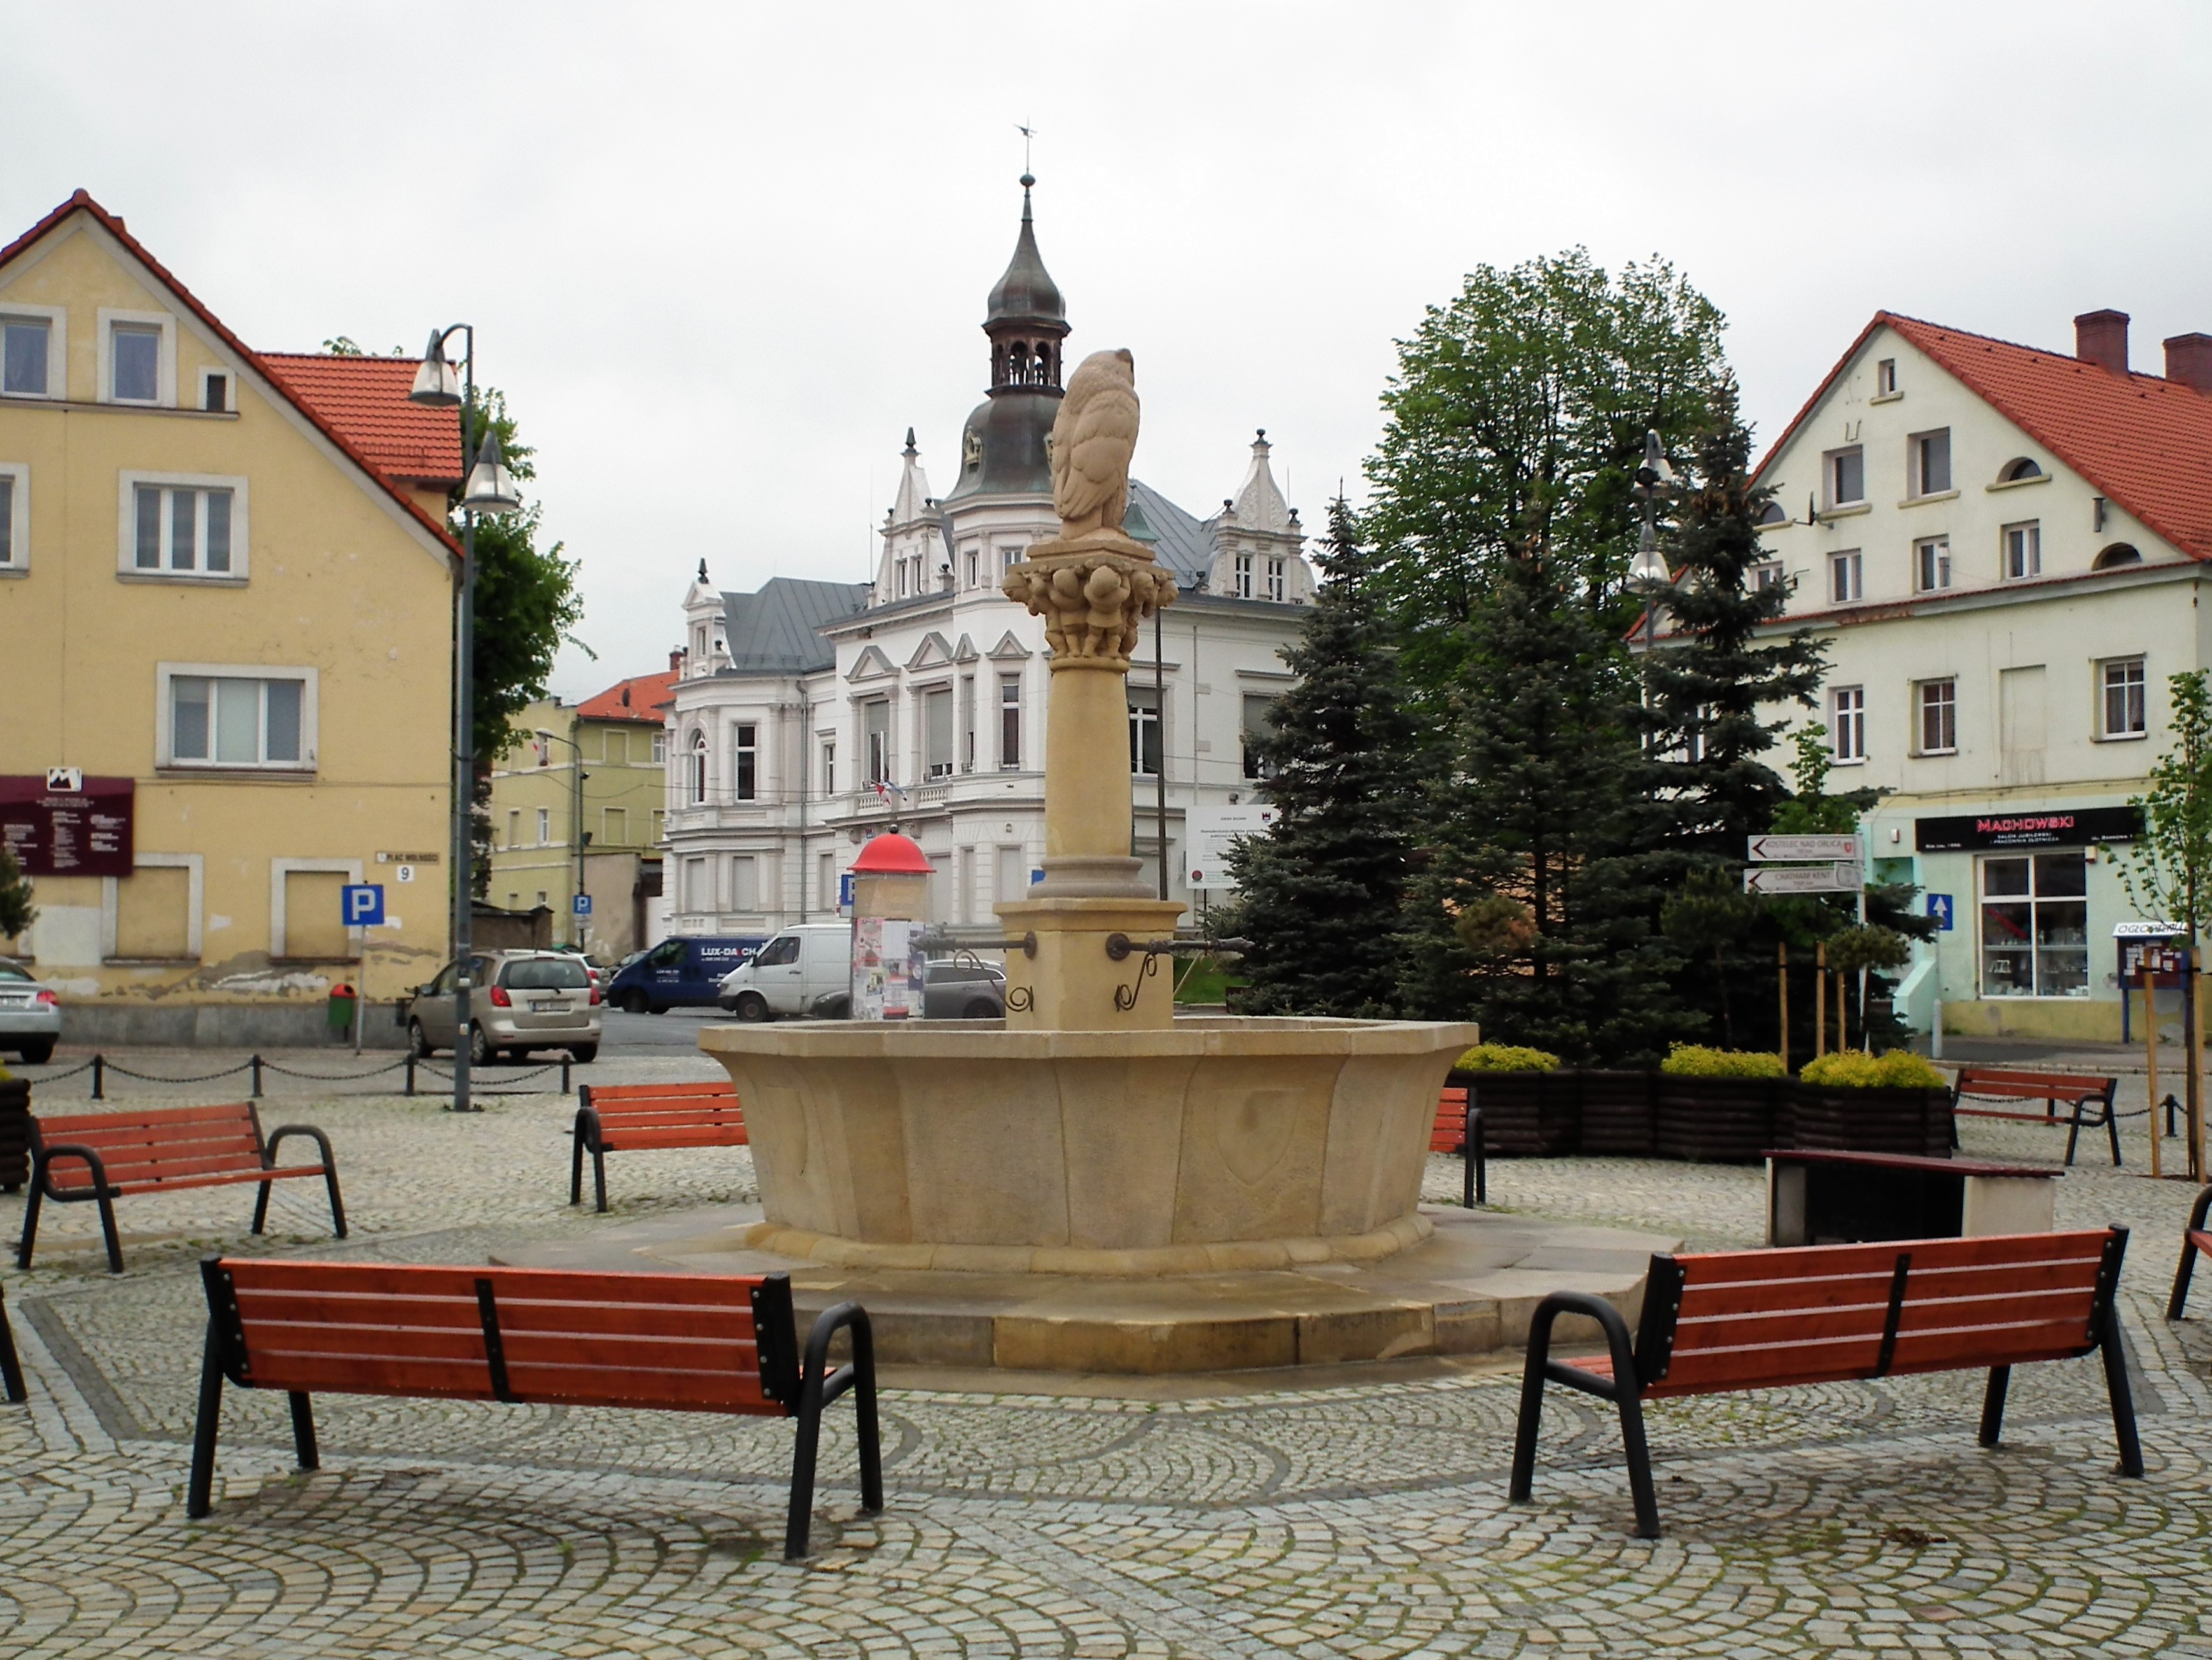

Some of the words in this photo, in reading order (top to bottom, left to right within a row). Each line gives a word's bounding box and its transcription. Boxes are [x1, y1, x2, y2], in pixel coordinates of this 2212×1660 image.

[1977, 815, 2074, 832] MACHOWSKI
[401, 866, 409, 880] 9
[351, 889, 376, 920] P
[577, 897, 589, 911] P
